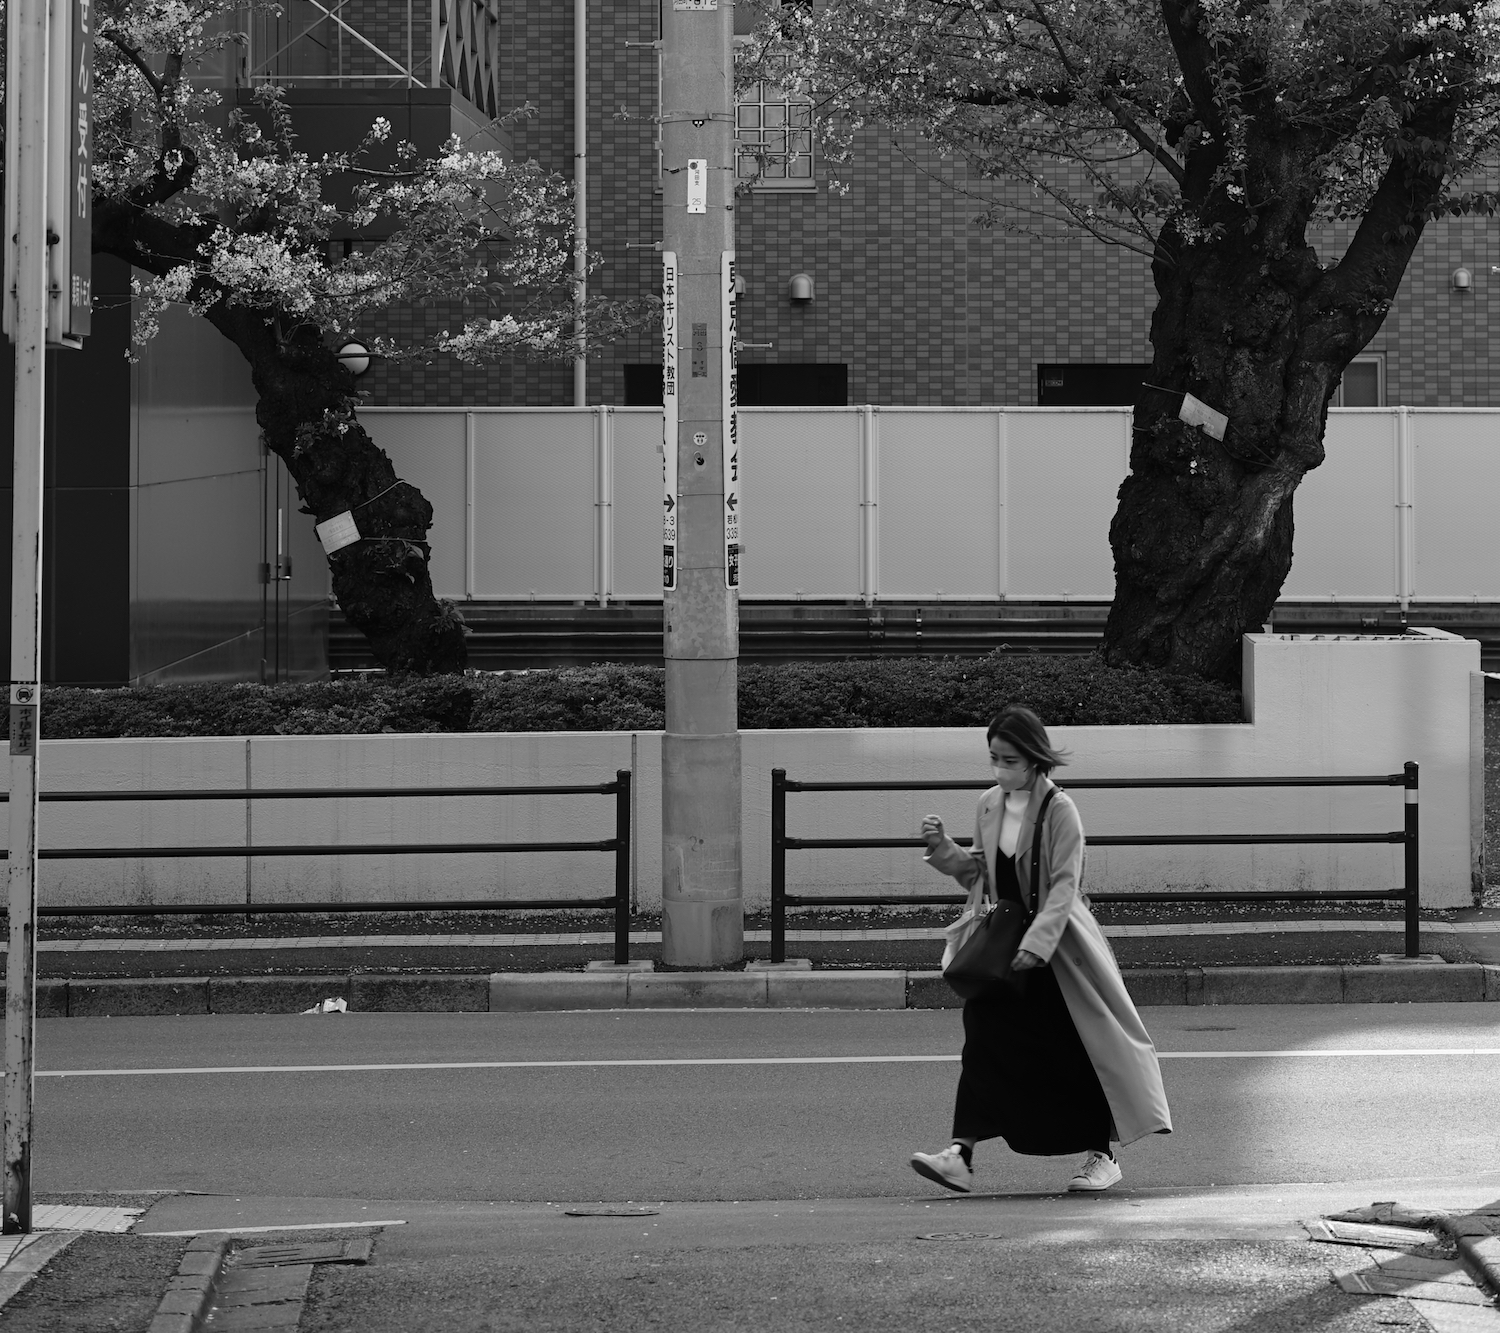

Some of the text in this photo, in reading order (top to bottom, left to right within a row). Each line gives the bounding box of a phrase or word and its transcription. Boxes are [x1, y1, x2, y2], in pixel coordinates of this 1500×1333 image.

[692, 197, 702, 206] 25
[666, 267, 675, 396] 日本キリスト教団
